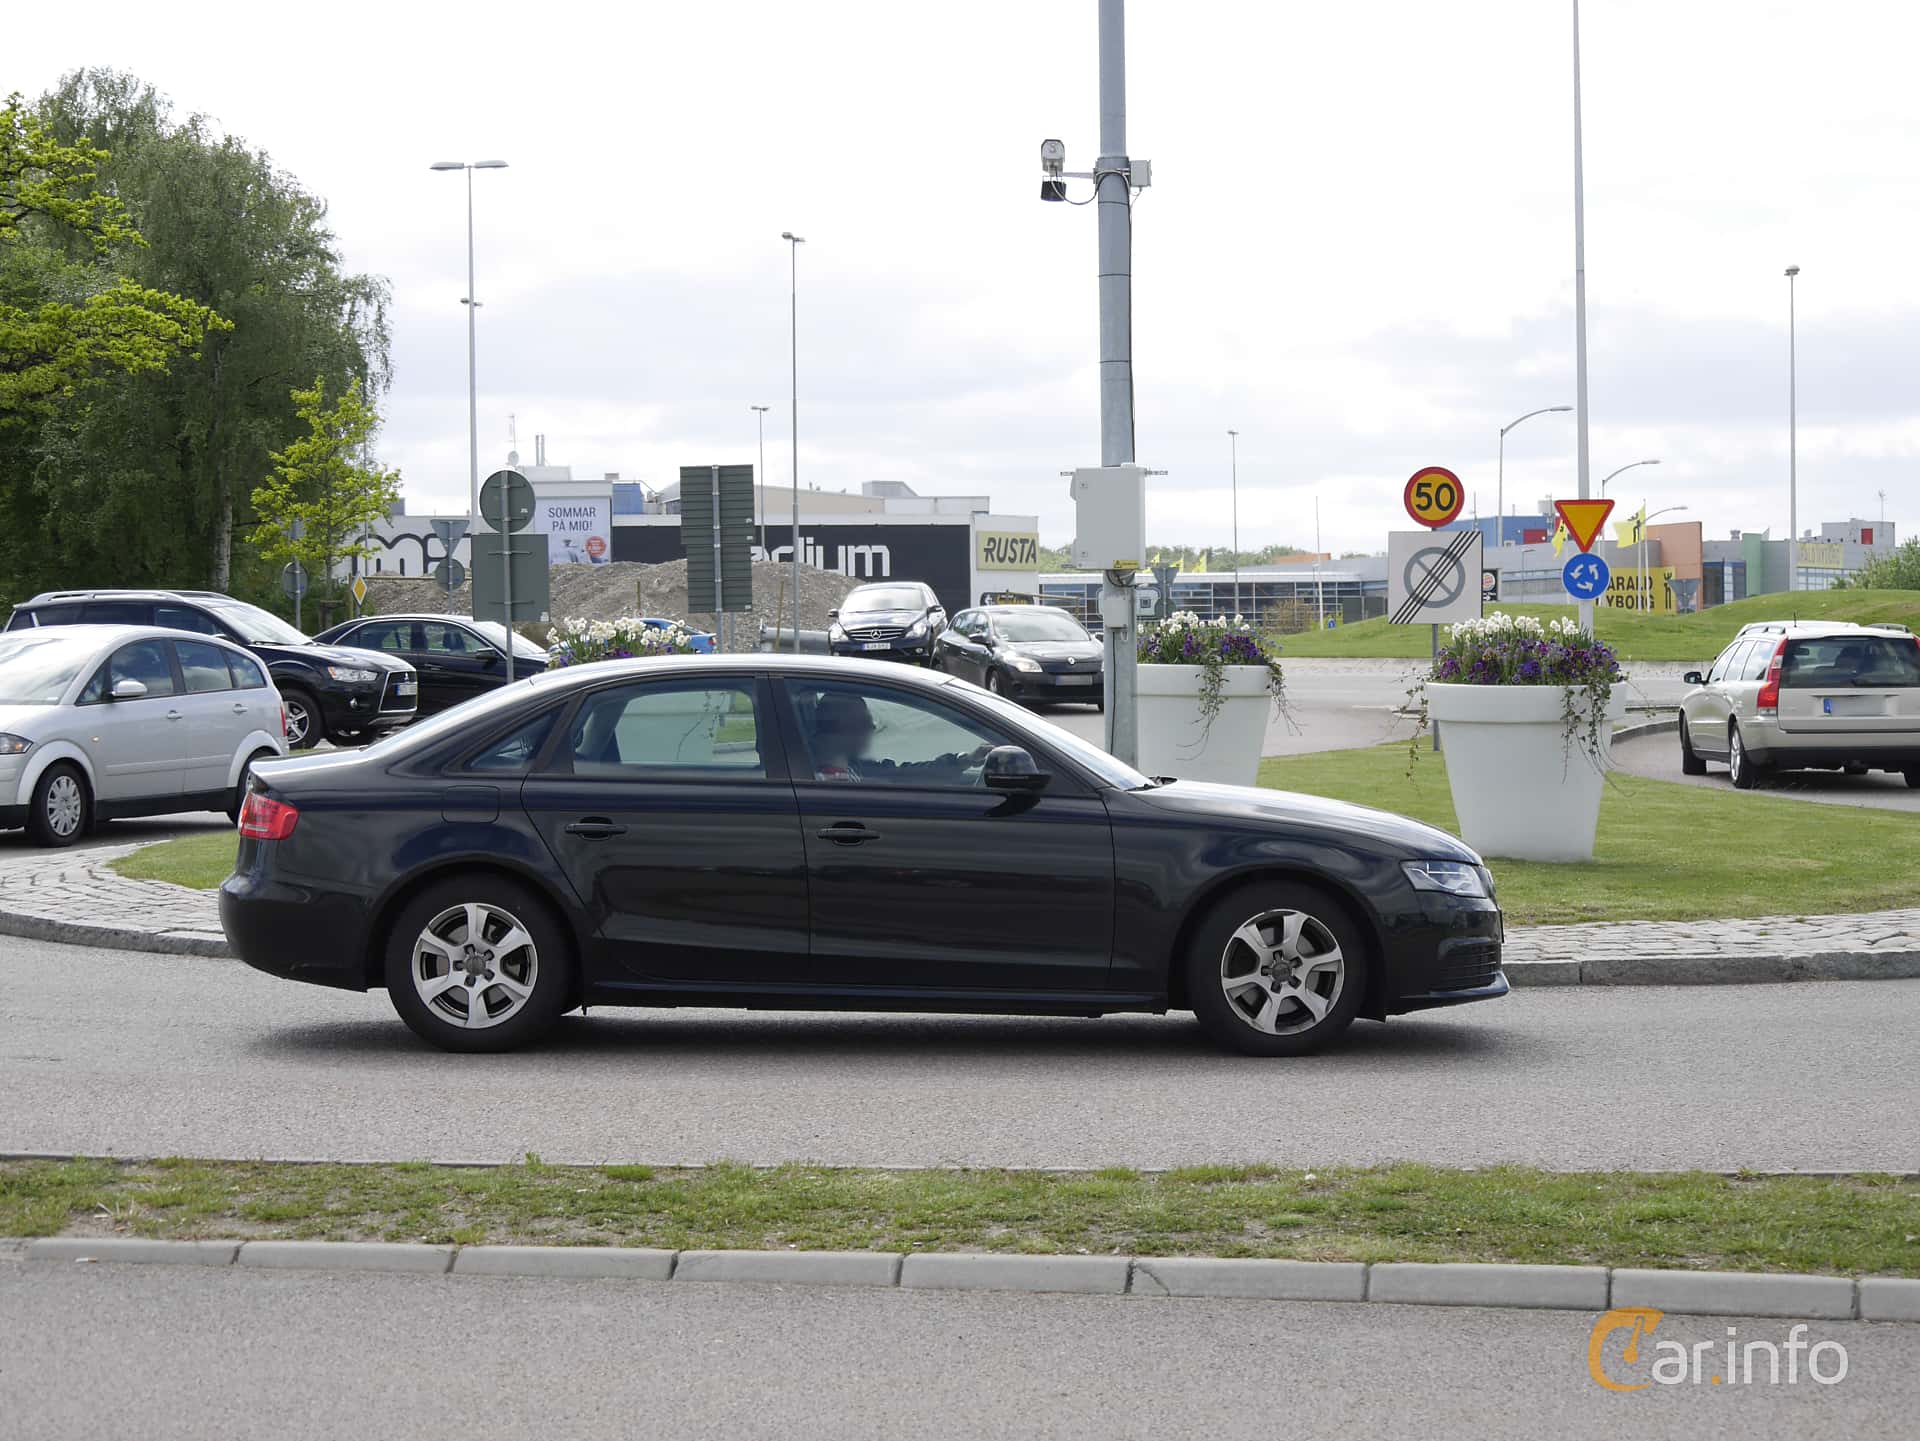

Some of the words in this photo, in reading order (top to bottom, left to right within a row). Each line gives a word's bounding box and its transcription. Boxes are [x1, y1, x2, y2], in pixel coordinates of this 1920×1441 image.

[1415, 483, 1455, 511] 50
[548, 507, 596, 518] SOMMAR
[552, 519, 565, 531] PÅ
[569, 520, 593, 531] MIO!
[984, 537, 1037, 564] RUSTA
